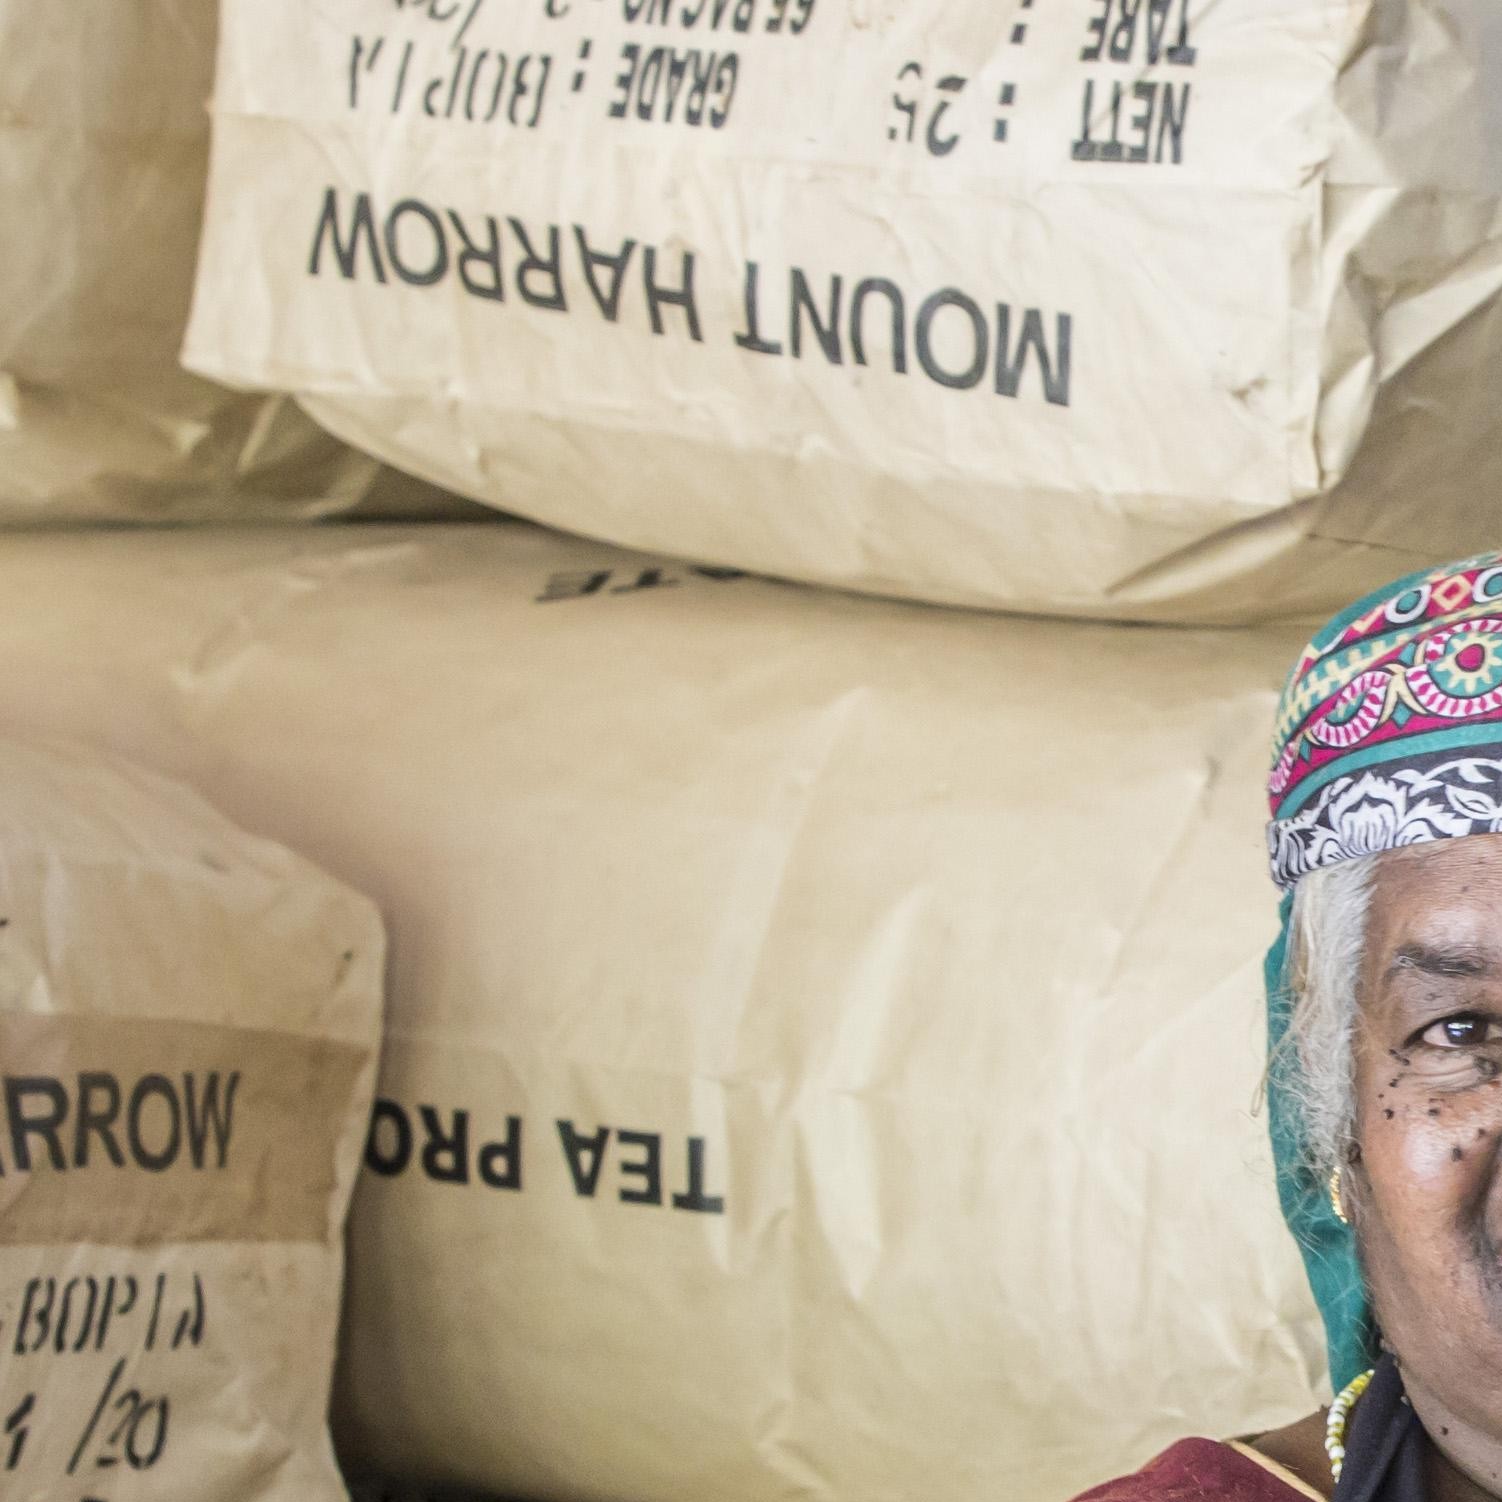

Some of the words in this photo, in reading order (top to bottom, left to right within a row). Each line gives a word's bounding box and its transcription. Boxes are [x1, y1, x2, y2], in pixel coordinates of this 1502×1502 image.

[888, 62, 967, 157] 25
[1071, 79, 1190, 164] NETT
[307, 187, 701, 341] HARROW
[733, 261, 1072, 405] MOUNT
[0, 1071, 241, 1178] RROW
[364, 1097, 522, 1191] PRO
[557, 1119, 725, 1214] TEA
